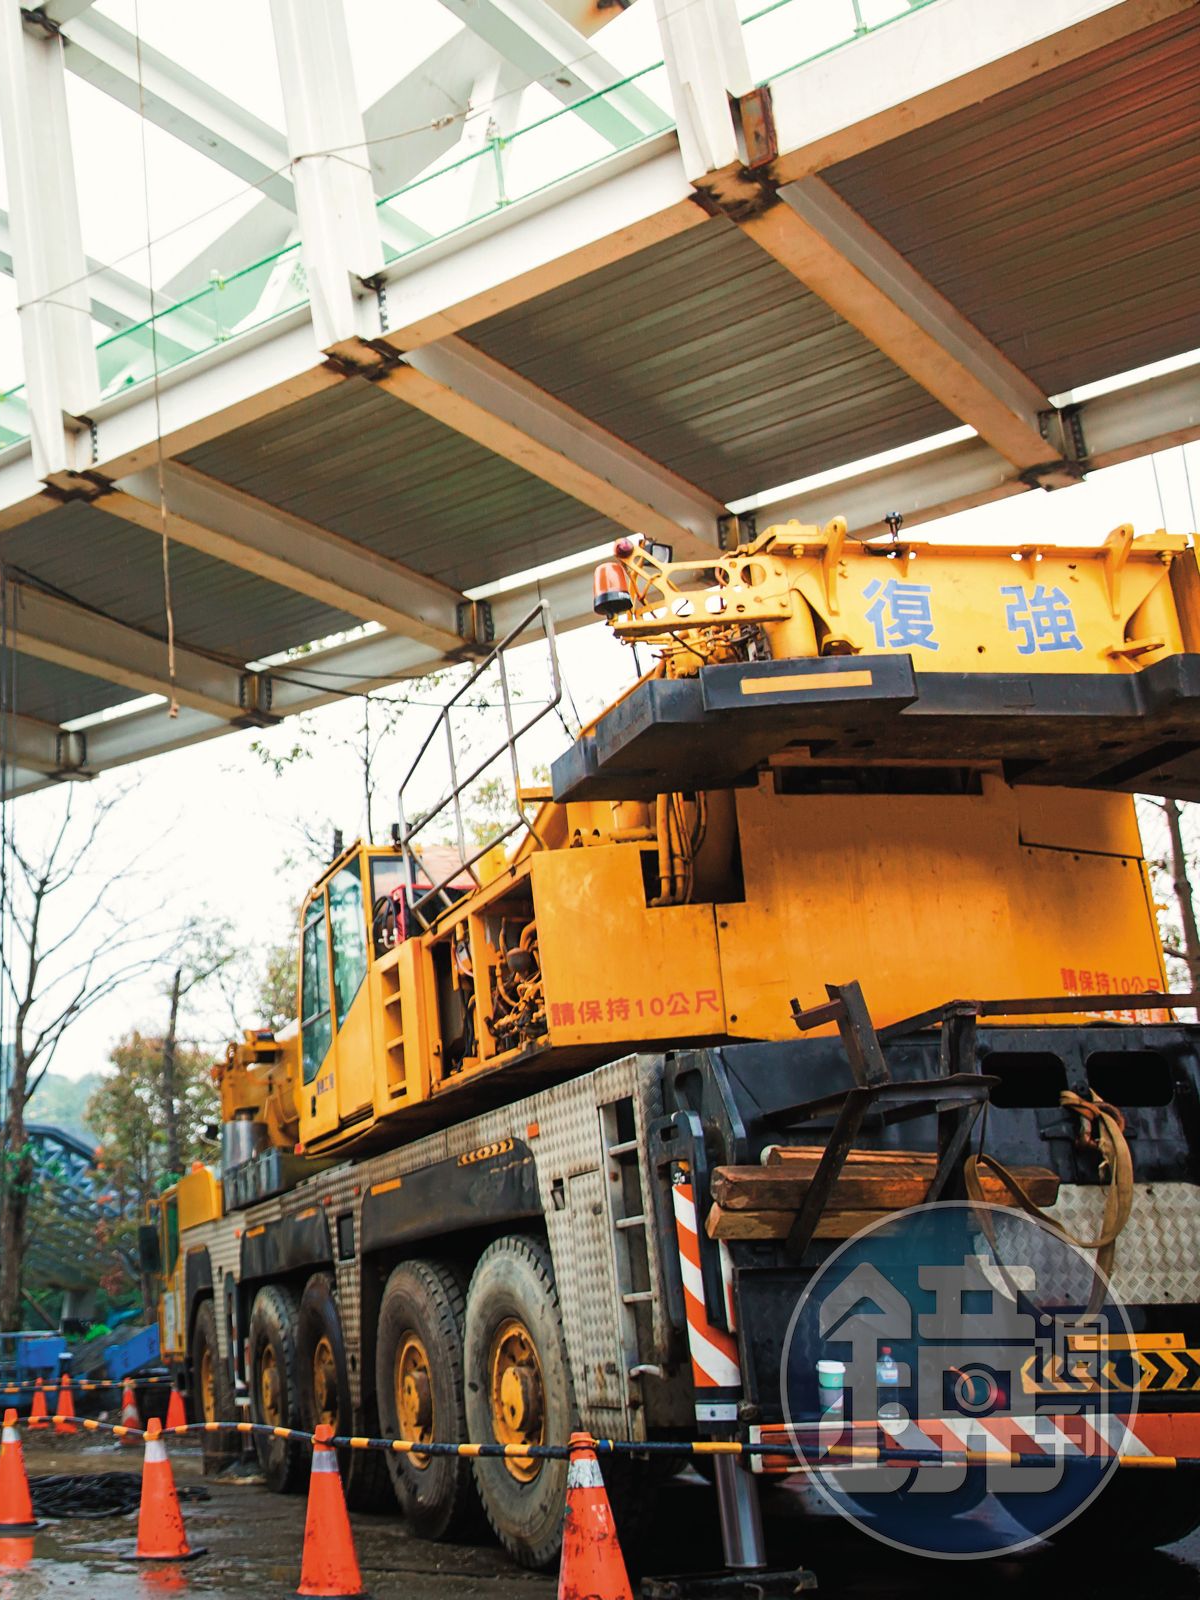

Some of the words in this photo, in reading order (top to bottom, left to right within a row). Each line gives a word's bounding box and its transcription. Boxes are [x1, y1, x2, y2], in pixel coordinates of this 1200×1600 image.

[550, 989, 721, 1027] 請保持10公尺
